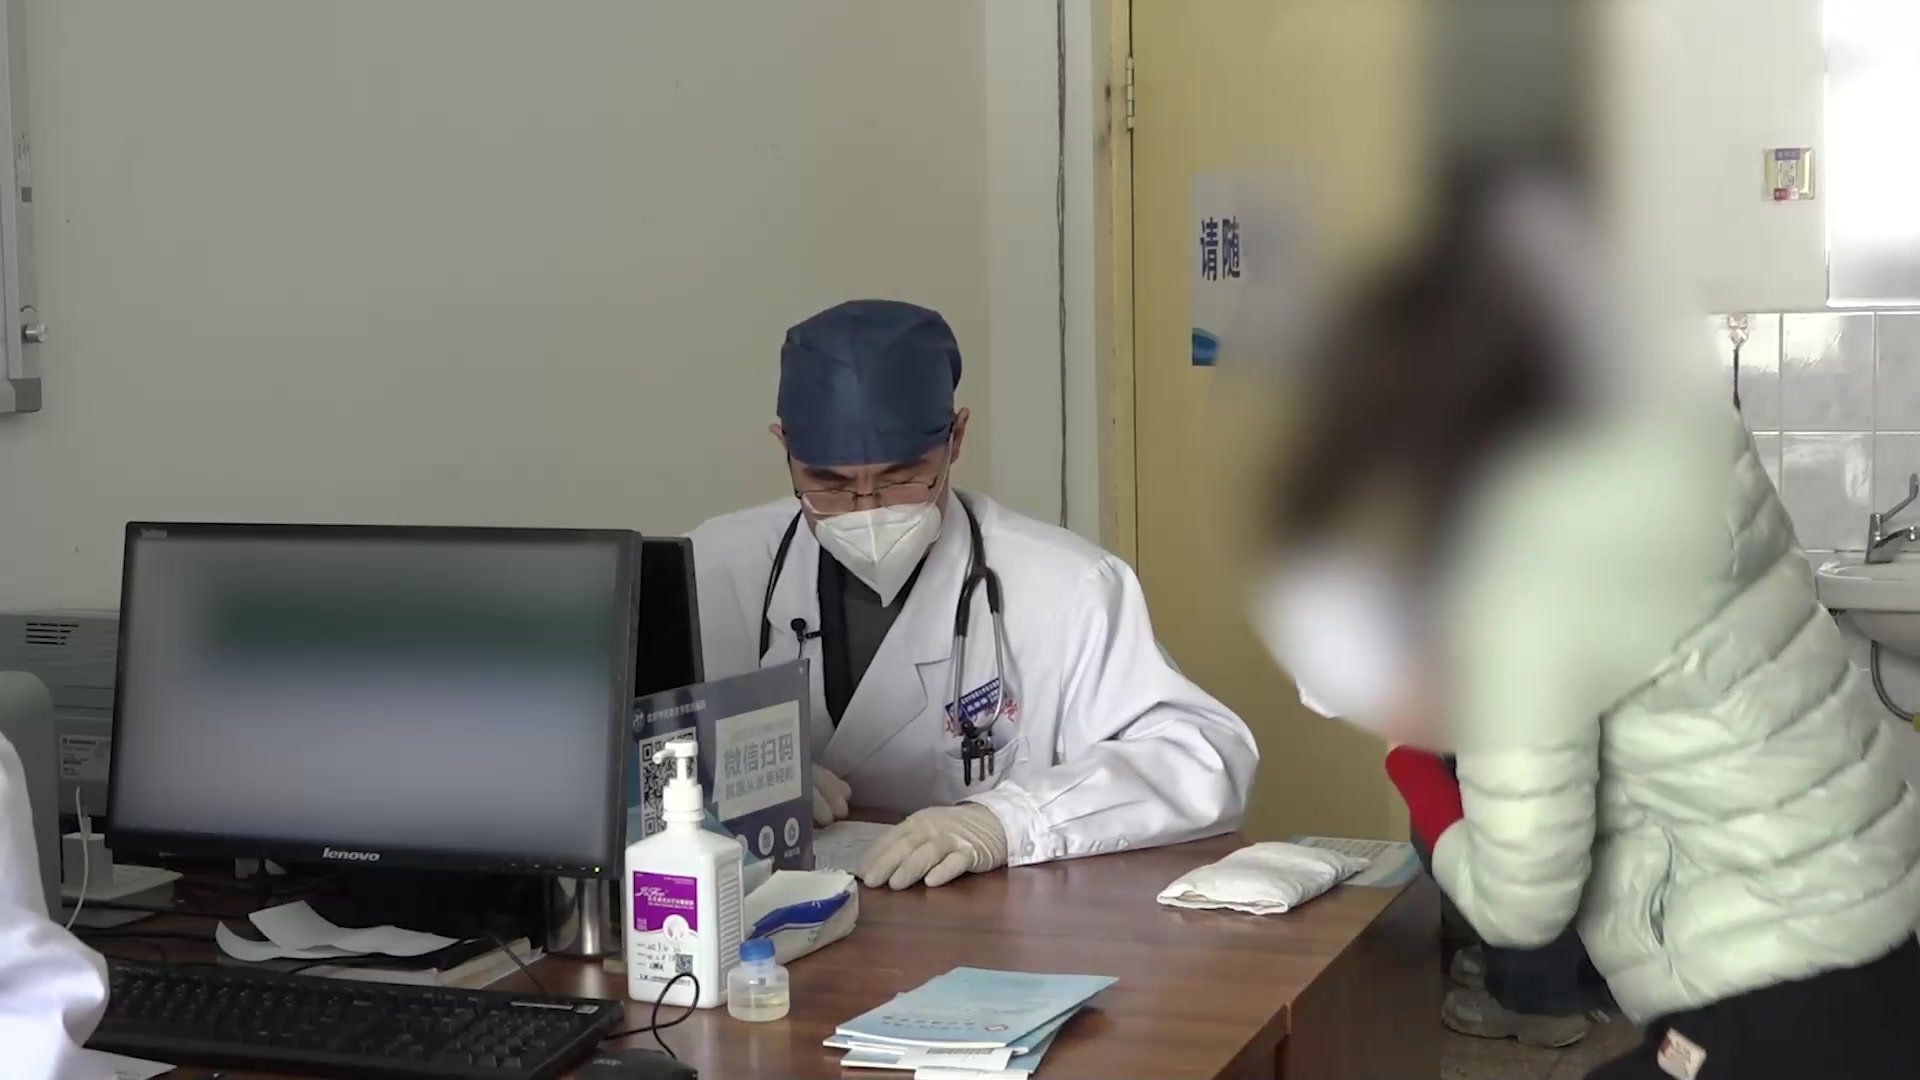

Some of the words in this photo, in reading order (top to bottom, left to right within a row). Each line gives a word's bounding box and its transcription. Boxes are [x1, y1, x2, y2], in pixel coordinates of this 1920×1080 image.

[1200, 216, 1240, 281] 请随
[723, 733, 793, 779] 微信扫码
[322, 847, 381, 862] lenovo
